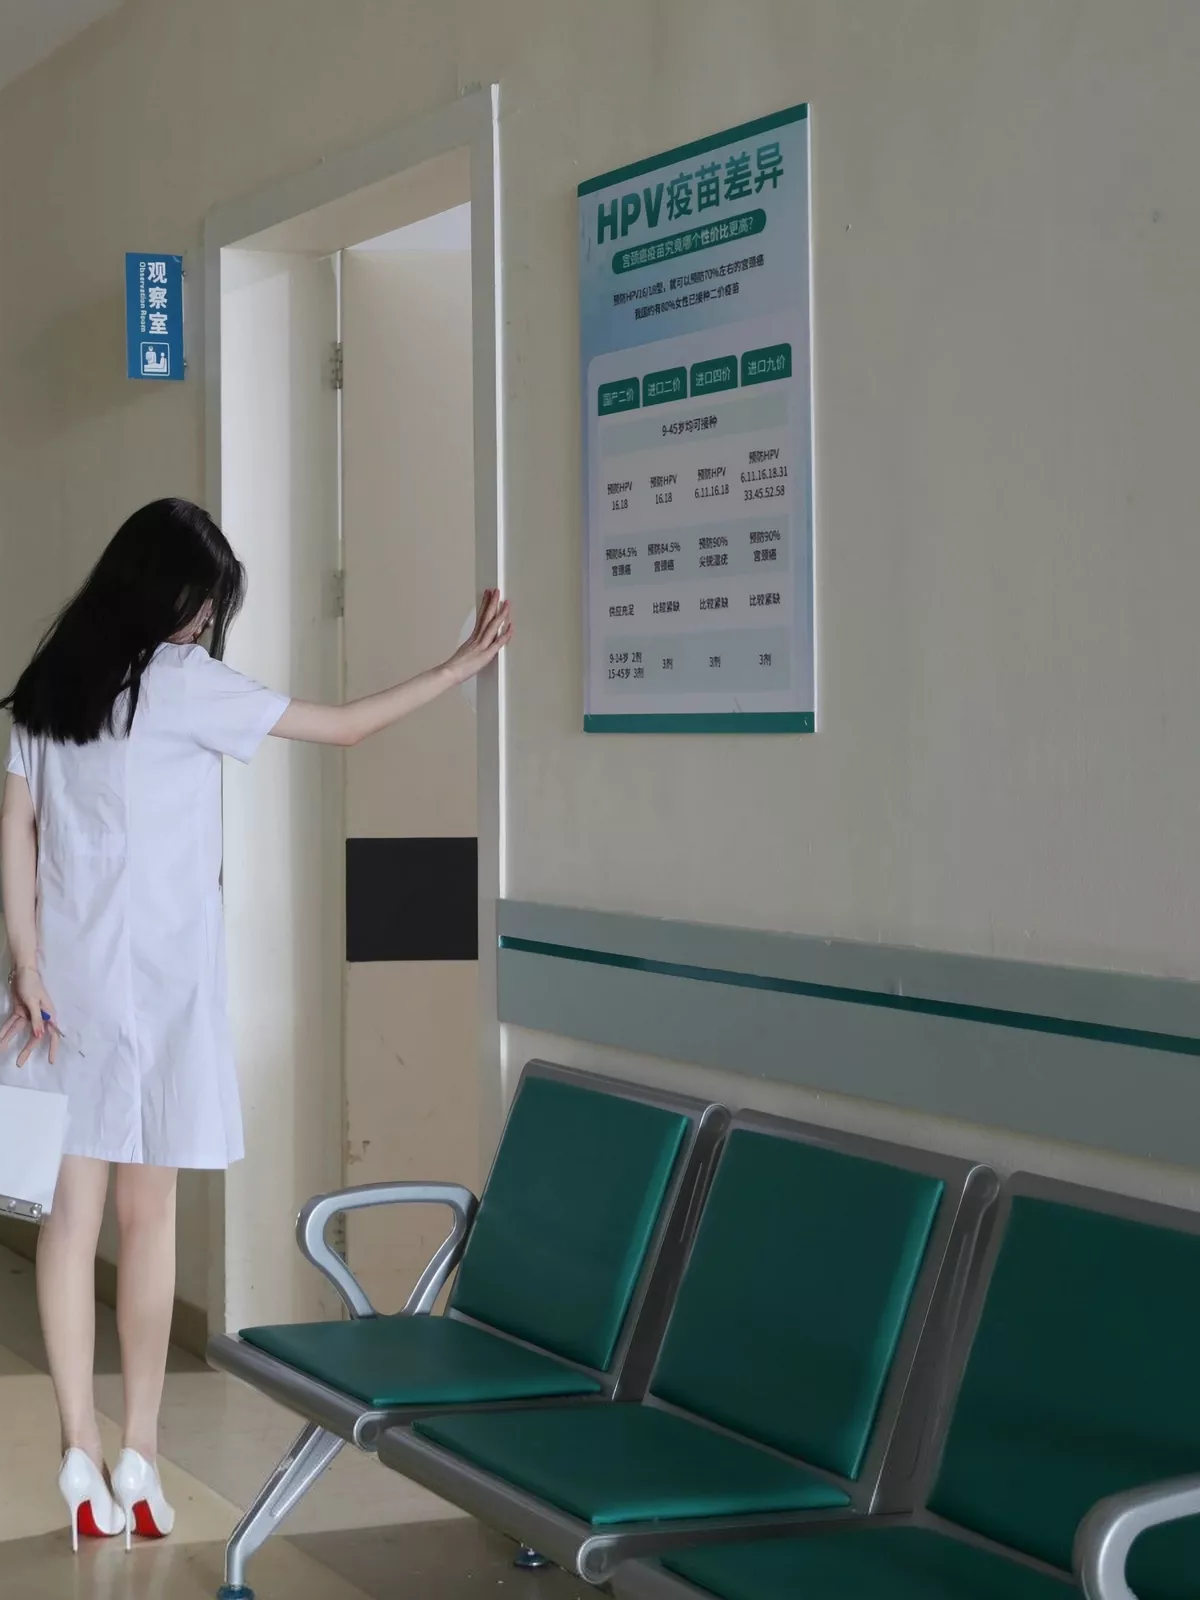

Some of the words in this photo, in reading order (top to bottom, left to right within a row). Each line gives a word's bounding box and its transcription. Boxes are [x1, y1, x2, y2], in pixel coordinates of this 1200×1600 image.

[597, 142, 784, 244] HPV疫苗差异
[147, 261, 169, 335] 观察室
[748, 354, 786, 376] 进口九价
[648, 377, 681, 397] 进口二价
[695, 367, 731, 387] 进口四价
[662, 415, 718, 437] 9-45岁均可接种
[749, 448, 780, 464] 预防HPV
[655, 492, 673, 505] 16.18
